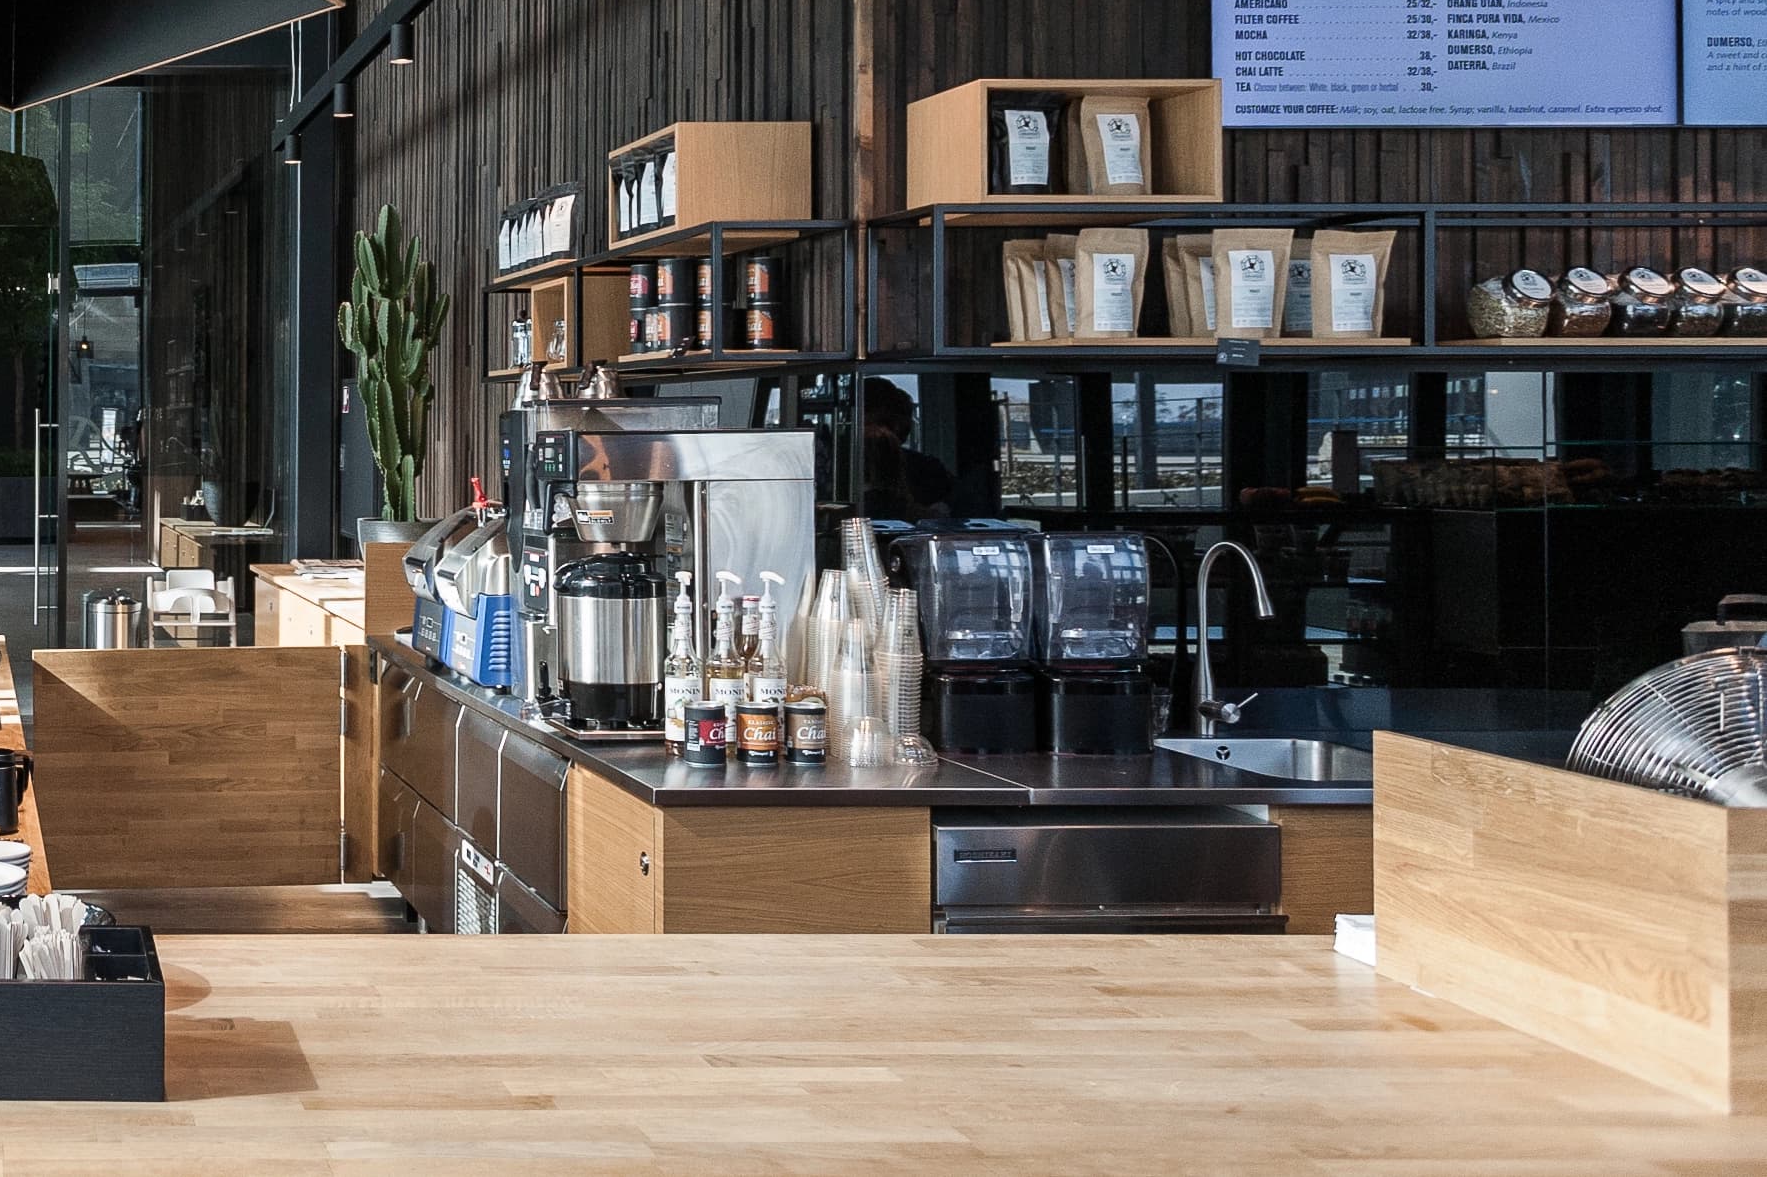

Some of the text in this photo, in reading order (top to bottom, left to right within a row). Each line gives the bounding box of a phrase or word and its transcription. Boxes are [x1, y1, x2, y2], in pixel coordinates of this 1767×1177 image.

[1235, 0, 1437, 8] AMERICANO 25/32,-
[1447, 0, 1548, 8] ORANG UTAN, Indonesia
[1706, 8, 1729, 16] notes
[1731, 8, 1741, 16] of
[1235, 15, 1263, 24] FILTER
[1266, 15, 1299, 24] COFFEE
[1448, 15, 1473, 23] FINCA
[1476, 14, 1500, 23] PURA
[1503, 14, 1525, 24] VIDA,
[1235, 30, 1438, 40] MOCHA 32/38,-
[1448, 30, 1518, 41] KARINGA, Kenya
[1707, 38, 1755, 48] DUMERSO,
[1235, 51, 1437, 61] HOT CHOCOLATE 38,-
[1448, 46, 1533, 56] DUMERSO, Ethiopia
[1716, 51, 1740, 59] sweet
[1743, 51, 1760, 59] and
[1448, 61, 1516, 70] DATERRA, Brazil
[1733, 63, 1750, 71] hint
[1752, 63, 1762, 72] of
[1236, 67, 1438, 77] CHAI LATTE 32/38,-
[1236, 83, 1251, 92] TEA
[1254, 83, 1277, 92] Choose
[1371, 84, 1377, 92] or
[1421, 83, 1438, 93] 30,-
[1236, 105, 1280, 114] CUSTOMIZE
[1283, 105, 1304, 114] YOUR
[1306, 105, 1339, 114] COFFEE:
[1364, 106, 1379, 115] soy,
[1381, 106, 1396, 114] oat,
[1399, 105, 1427, 114] lactose
[1585, 105, 1605, 113] Extra
[1607, 106, 1641, 115] espresso
[744, 726, 776, 741] Chai
